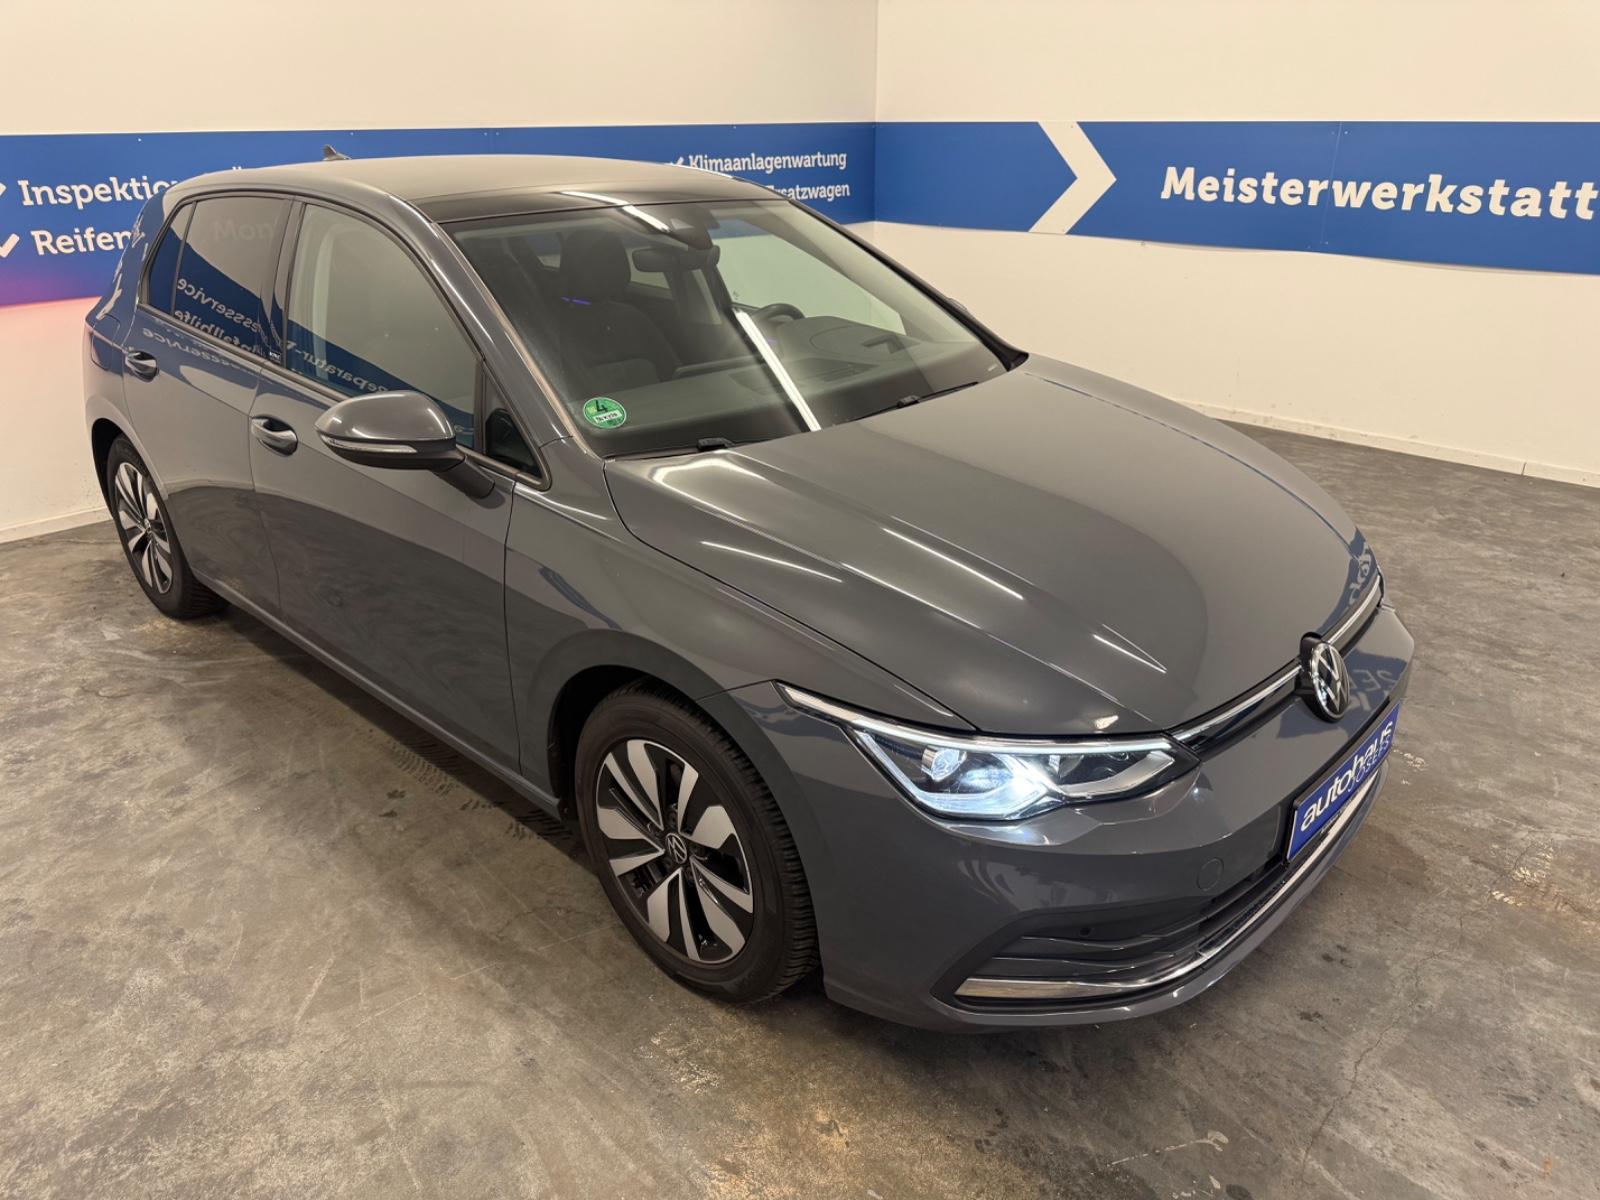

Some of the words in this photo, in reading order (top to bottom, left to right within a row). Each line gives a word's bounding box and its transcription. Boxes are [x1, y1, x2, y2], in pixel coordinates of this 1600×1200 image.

[688, 152, 847, 174] Klimaanlagenwartung
[17, 175, 178, 210] Inspektio
[1160, 166, 1600, 220] Meisterwerkstatt
